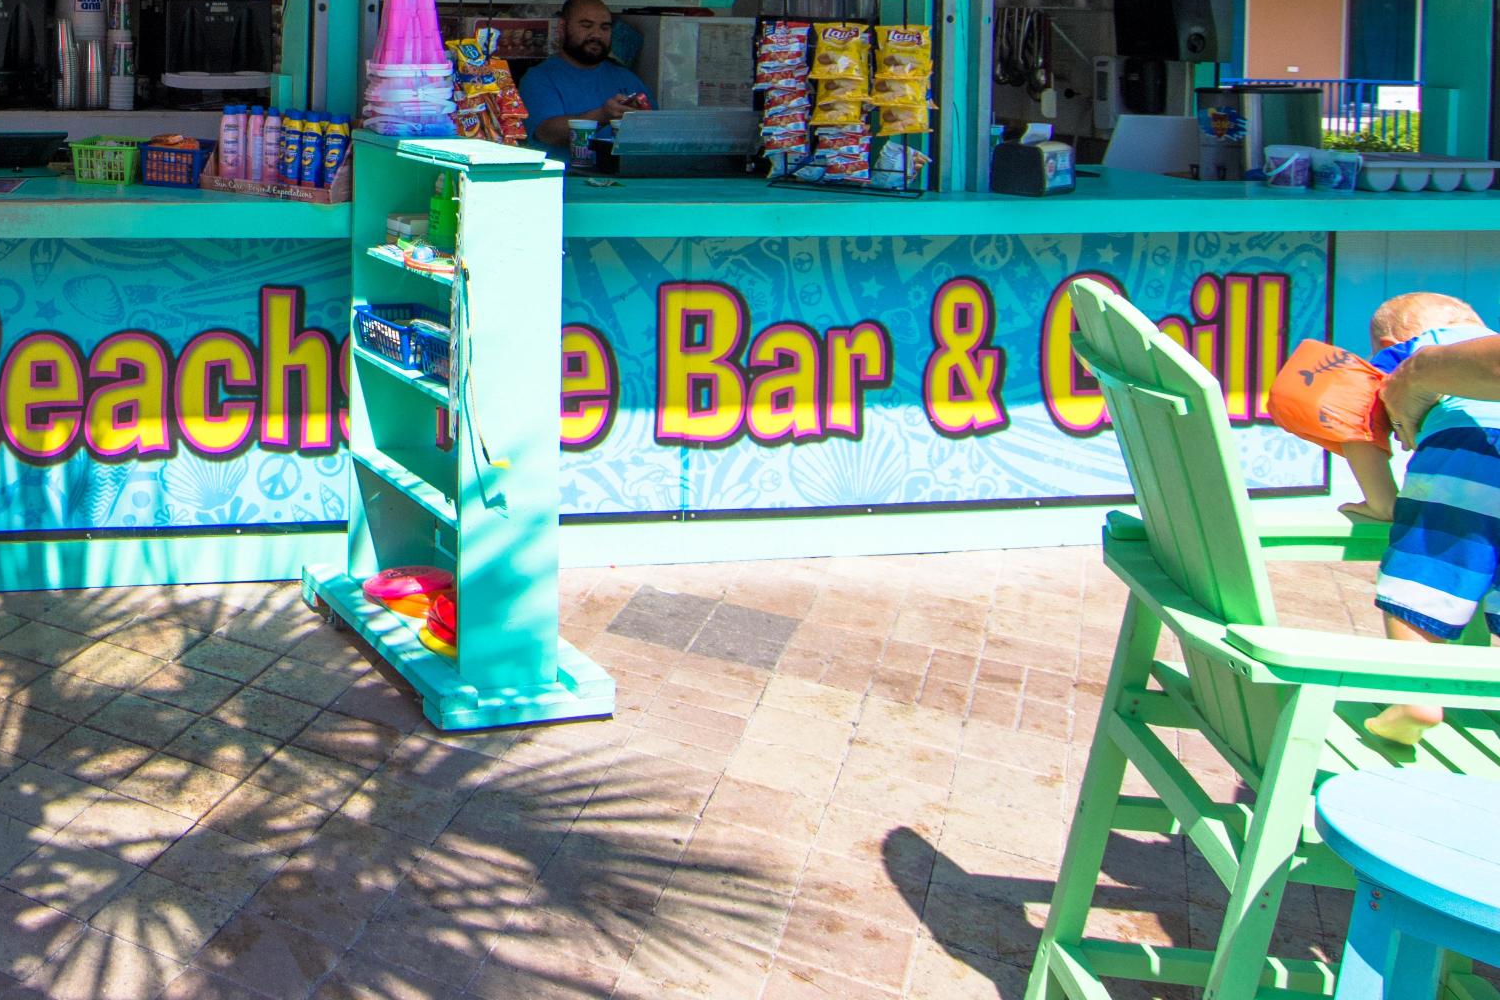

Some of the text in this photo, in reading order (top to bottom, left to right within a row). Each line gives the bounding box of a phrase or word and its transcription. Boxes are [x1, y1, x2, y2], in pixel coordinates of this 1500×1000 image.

[81, 2, 101, 10] BUD
[272, 186, 313, 199] Expectations
[655, 279, 888, 445] Bar
[924, 275, 1006, 437] &
[1041, 271, 1290, 434] Gill
